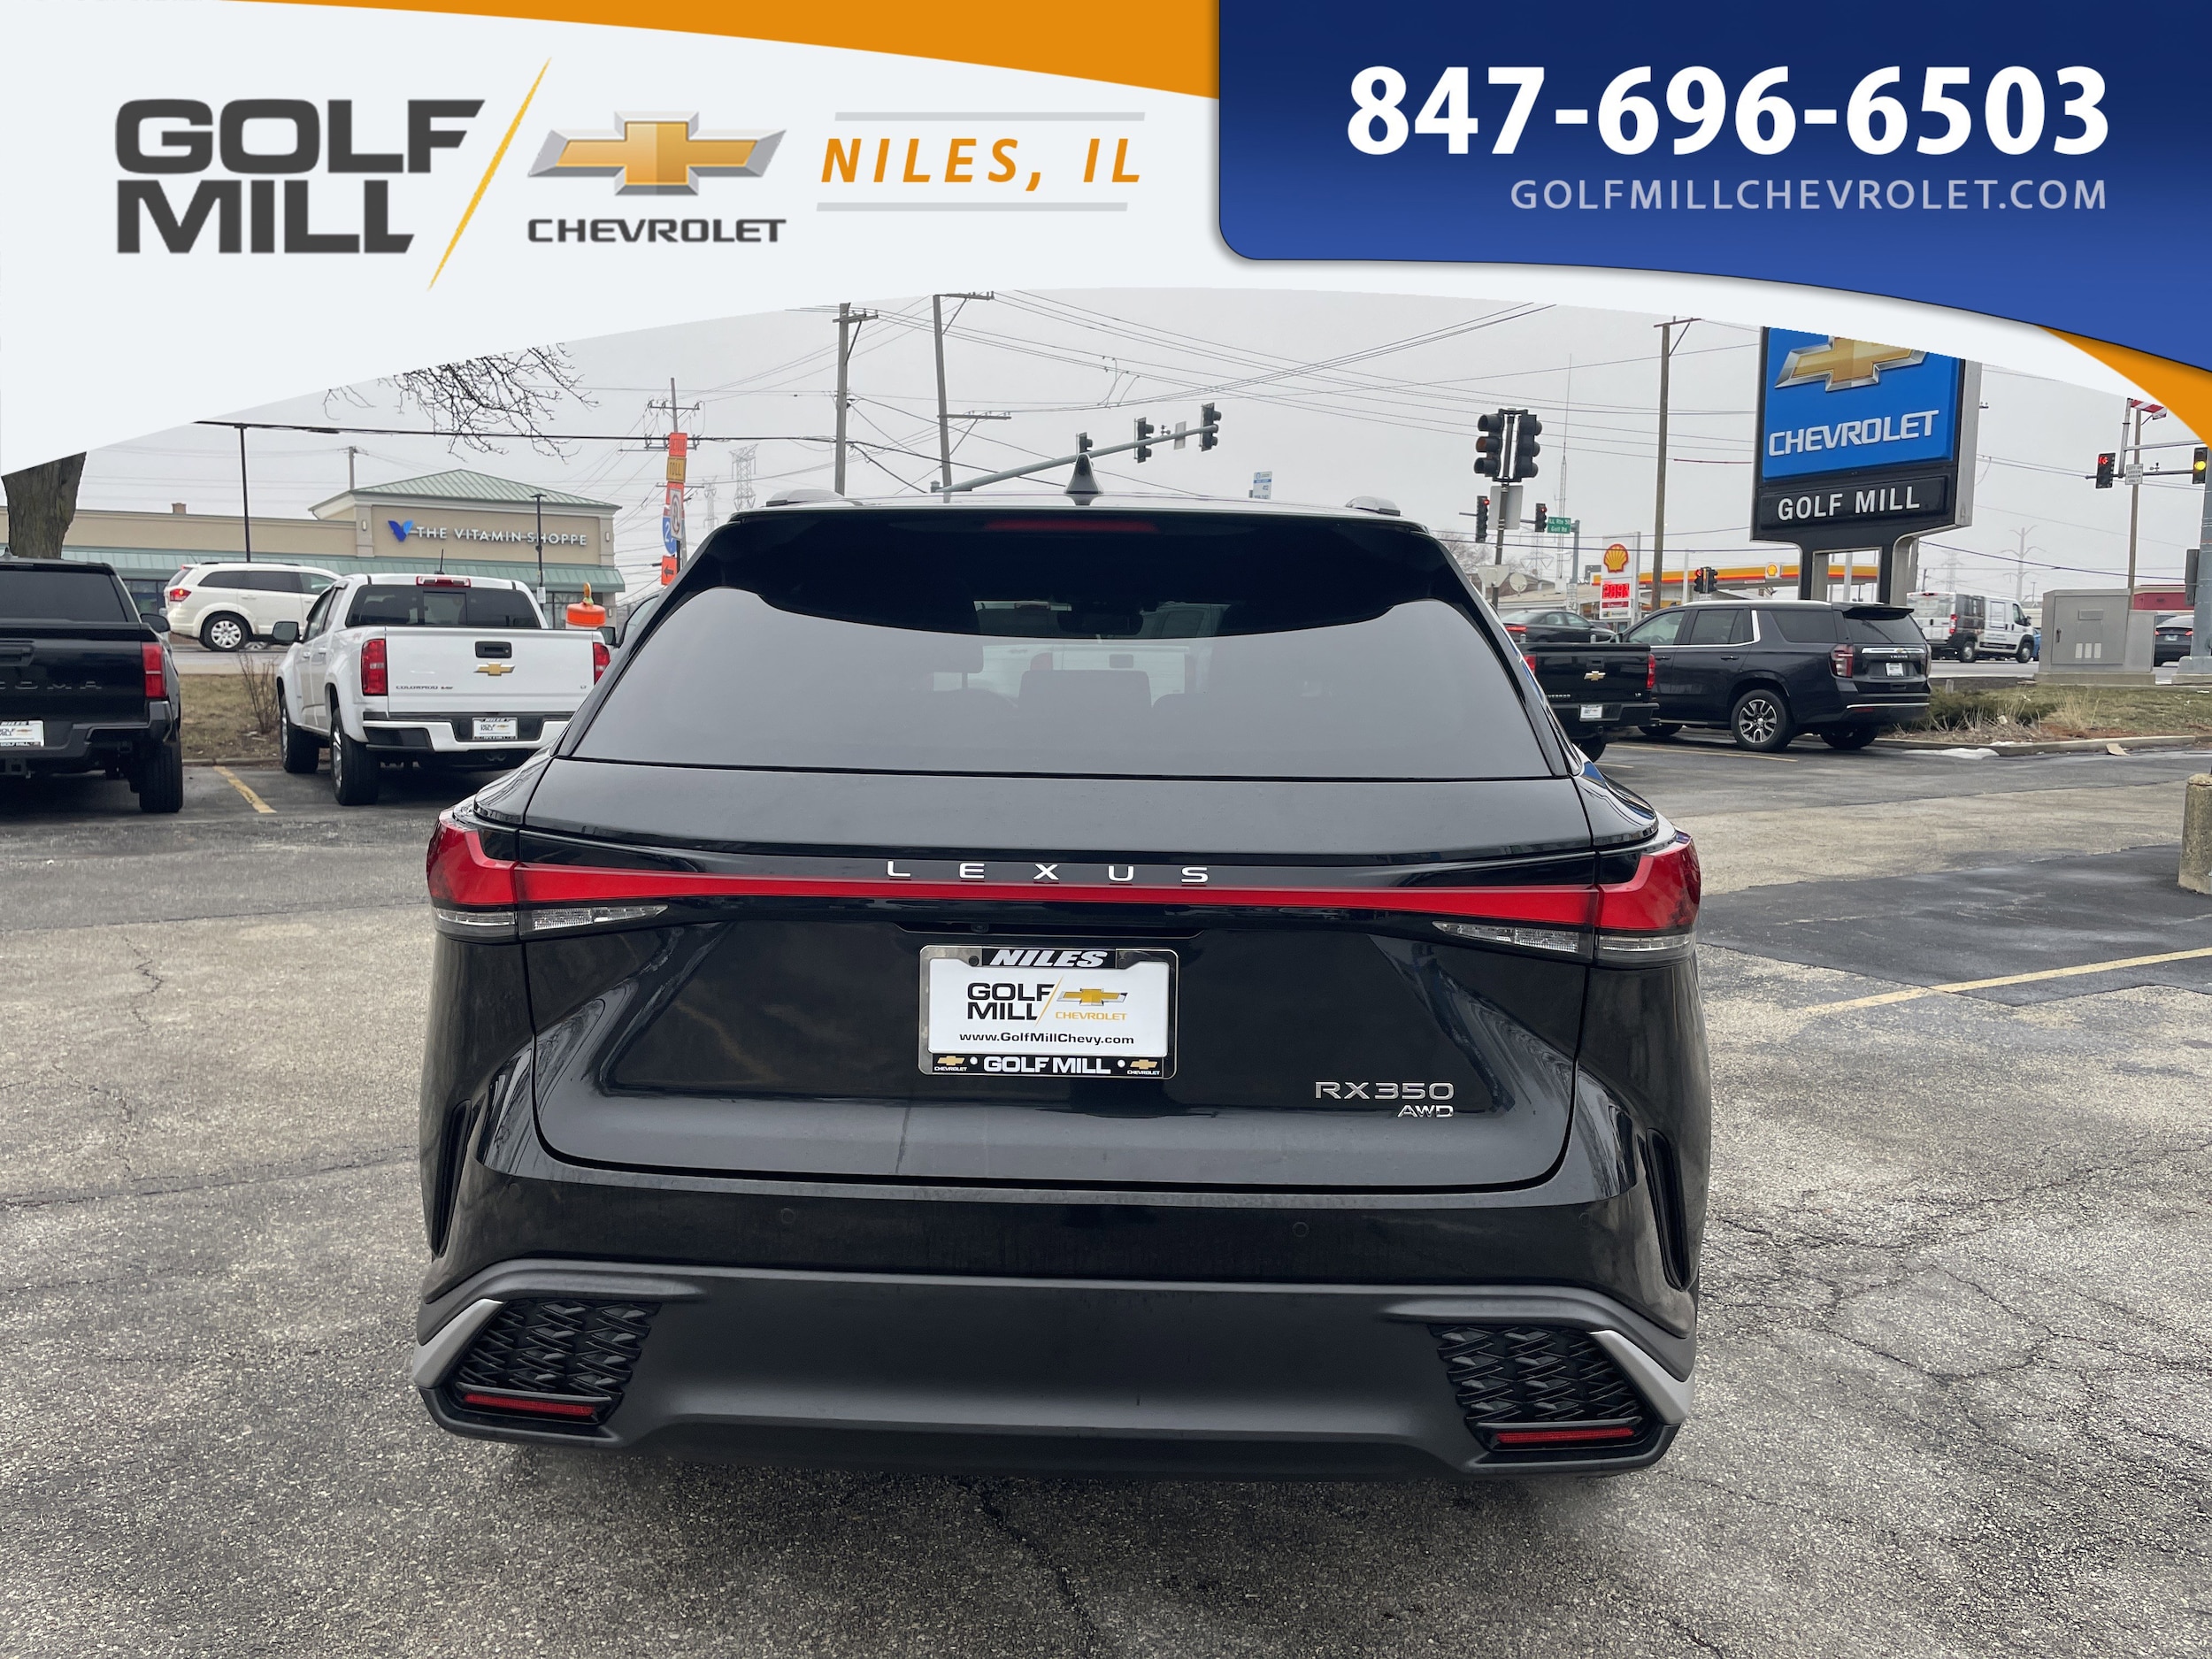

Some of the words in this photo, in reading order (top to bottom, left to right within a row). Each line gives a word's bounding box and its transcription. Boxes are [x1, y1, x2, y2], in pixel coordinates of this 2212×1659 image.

[1768, 409, 1940, 457] CHEVROLET
[669, 462, 681, 476] TOLL
[1778, 493, 1844, 521] GOLF
[1855, 486, 1921, 515] MILL
[416, 526, 448, 539] THE
[454, 528, 521, 542] VITAMIN
[526, 532, 588, 546] SHOPPE
[0, 680, 103, 690] OMA
[886, 860, 1210, 883] LEXUS
[989, 949, 1109, 968] NILES
[967, 983, 1056, 1002] GOLF
[967, 1002, 1039, 1020] MILL
[1055, 1011, 1128, 1022] CHEVROLET
[959, 1032, 1135, 1045] www.GolfMillChevy.com
[983, 1056, 1050, 1073] GOLF
[1052, 1057, 1111, 1075] MILL
[1314, 1081, 1455, 1101] RX350
[1396, 1104, 1455, 1118] AWD
